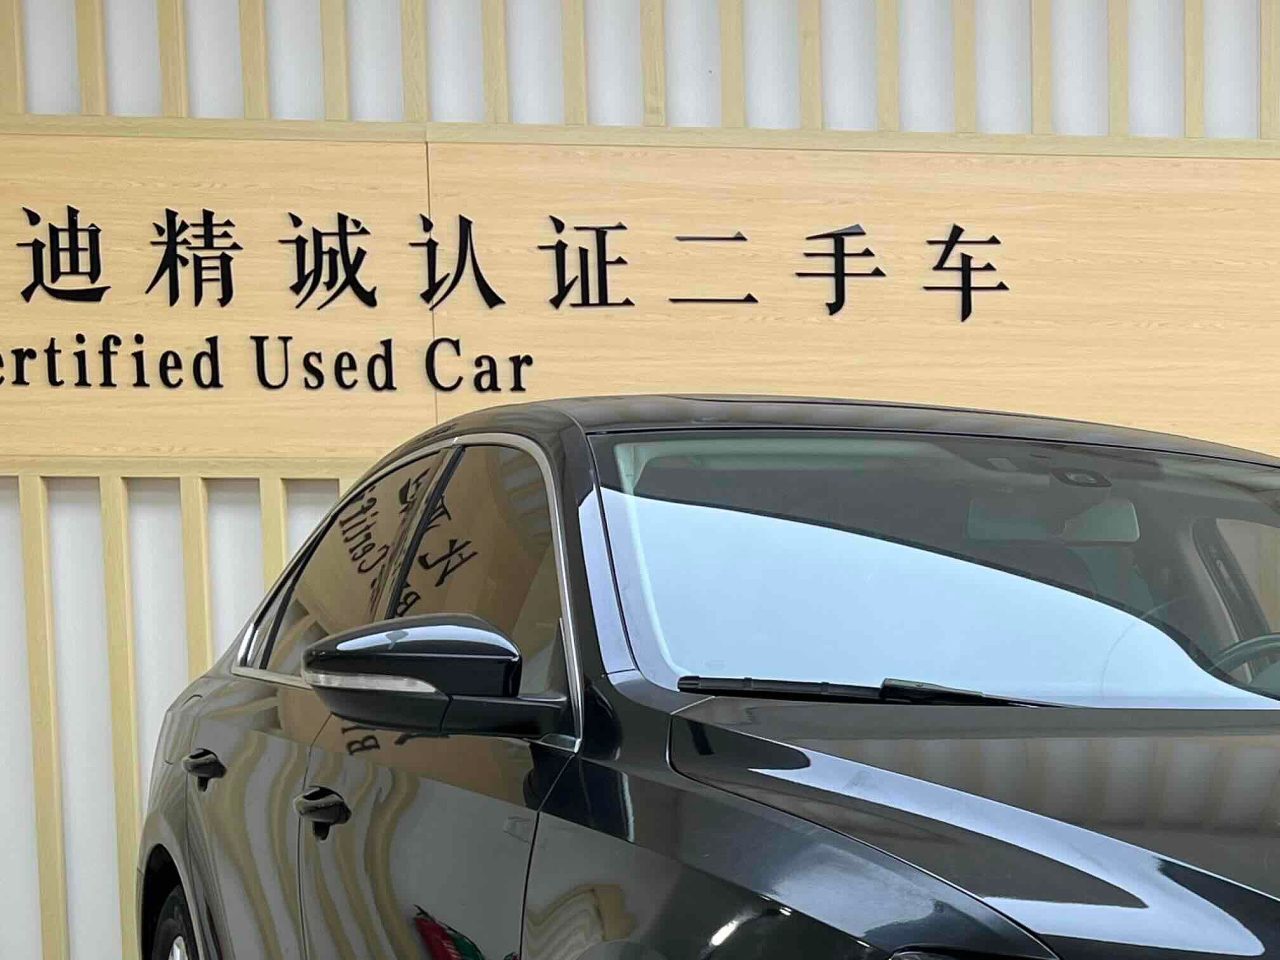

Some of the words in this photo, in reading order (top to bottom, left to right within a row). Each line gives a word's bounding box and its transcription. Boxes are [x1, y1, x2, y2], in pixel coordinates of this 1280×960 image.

[16, 205, 1009, 322] 迪精诚认证二手车
[0, 333, 224, 389] rtified
[250, 335, 397, 392] Used
[425, 337, 534, 392] Car
